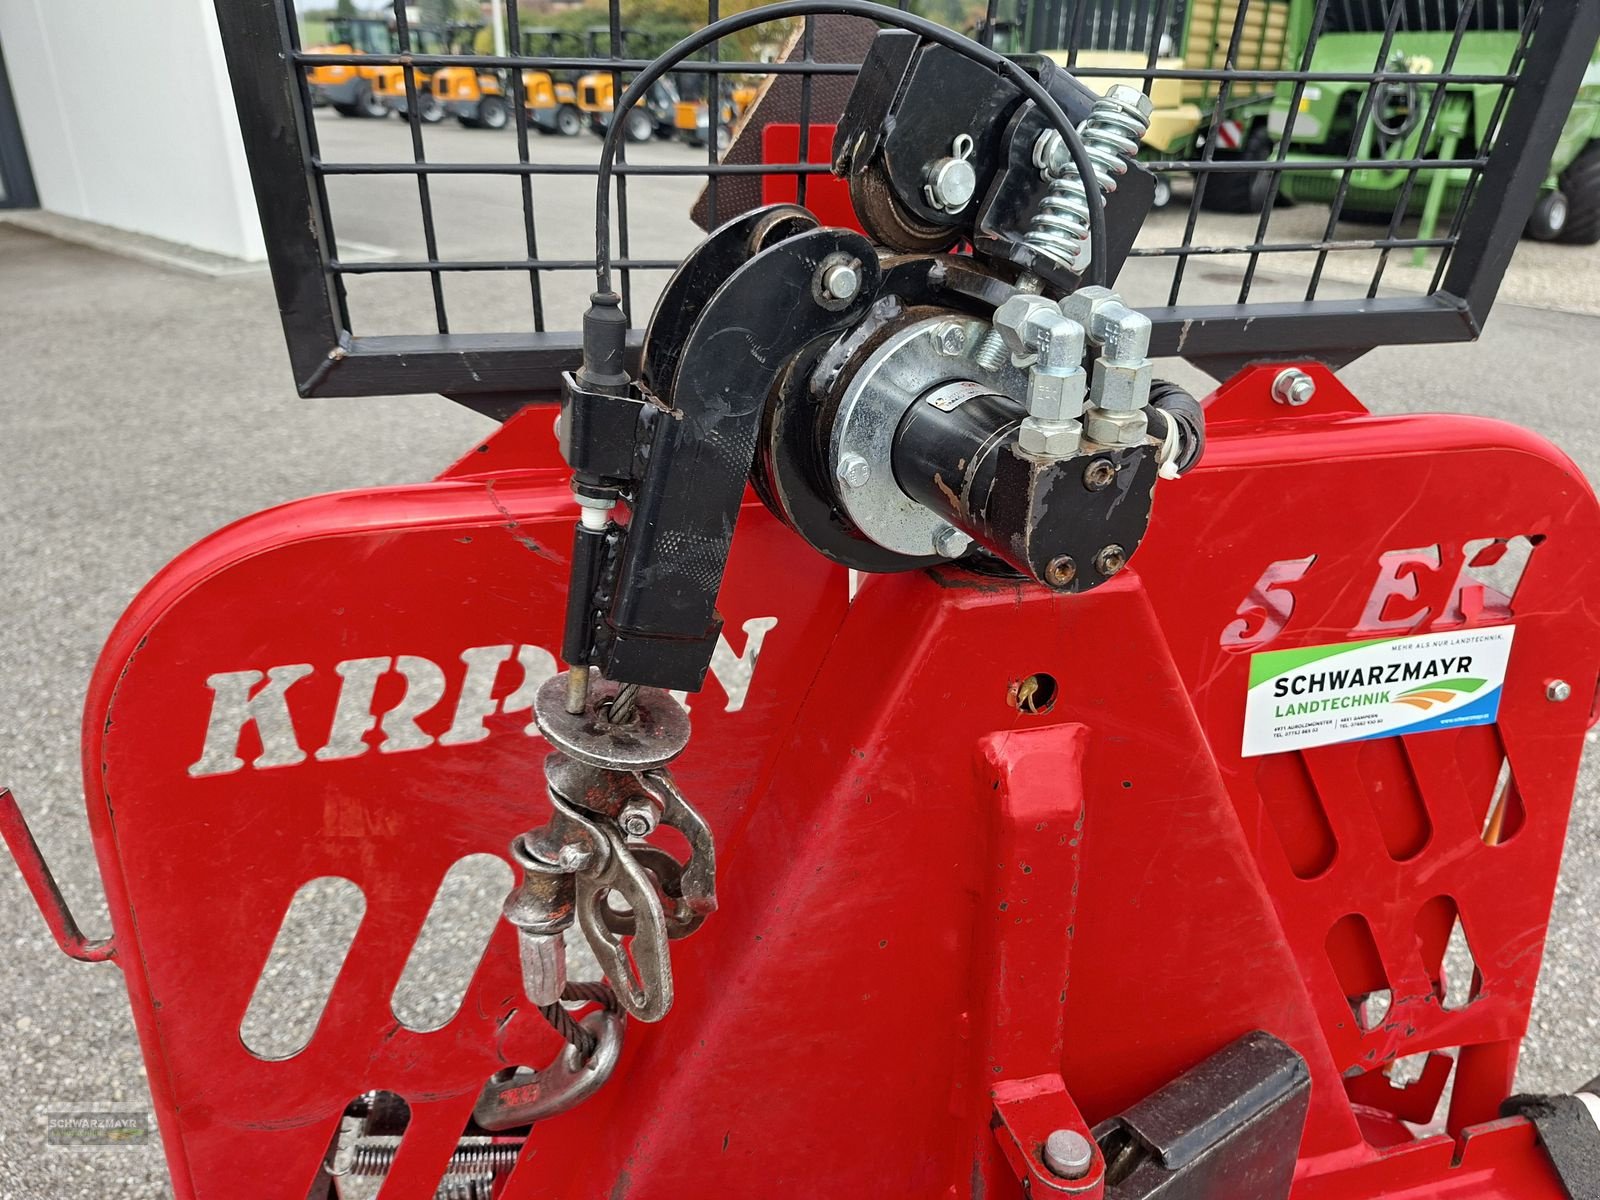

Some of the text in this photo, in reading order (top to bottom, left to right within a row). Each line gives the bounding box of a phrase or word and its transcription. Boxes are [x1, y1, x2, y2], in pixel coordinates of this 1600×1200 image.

[1219, 553, 1318, 654] 5
[1391, 643, 1413, 651] MEHR
[1415, 641, 1430, 649] ALS
[1433, 639, 1448, 647] NUR
[187, 616, 778, 778] KRPN
[1273, 655, 1473, 698] SCHWARZMAYR
[1275, 690, 1391, 718] LANDTECHNIK
